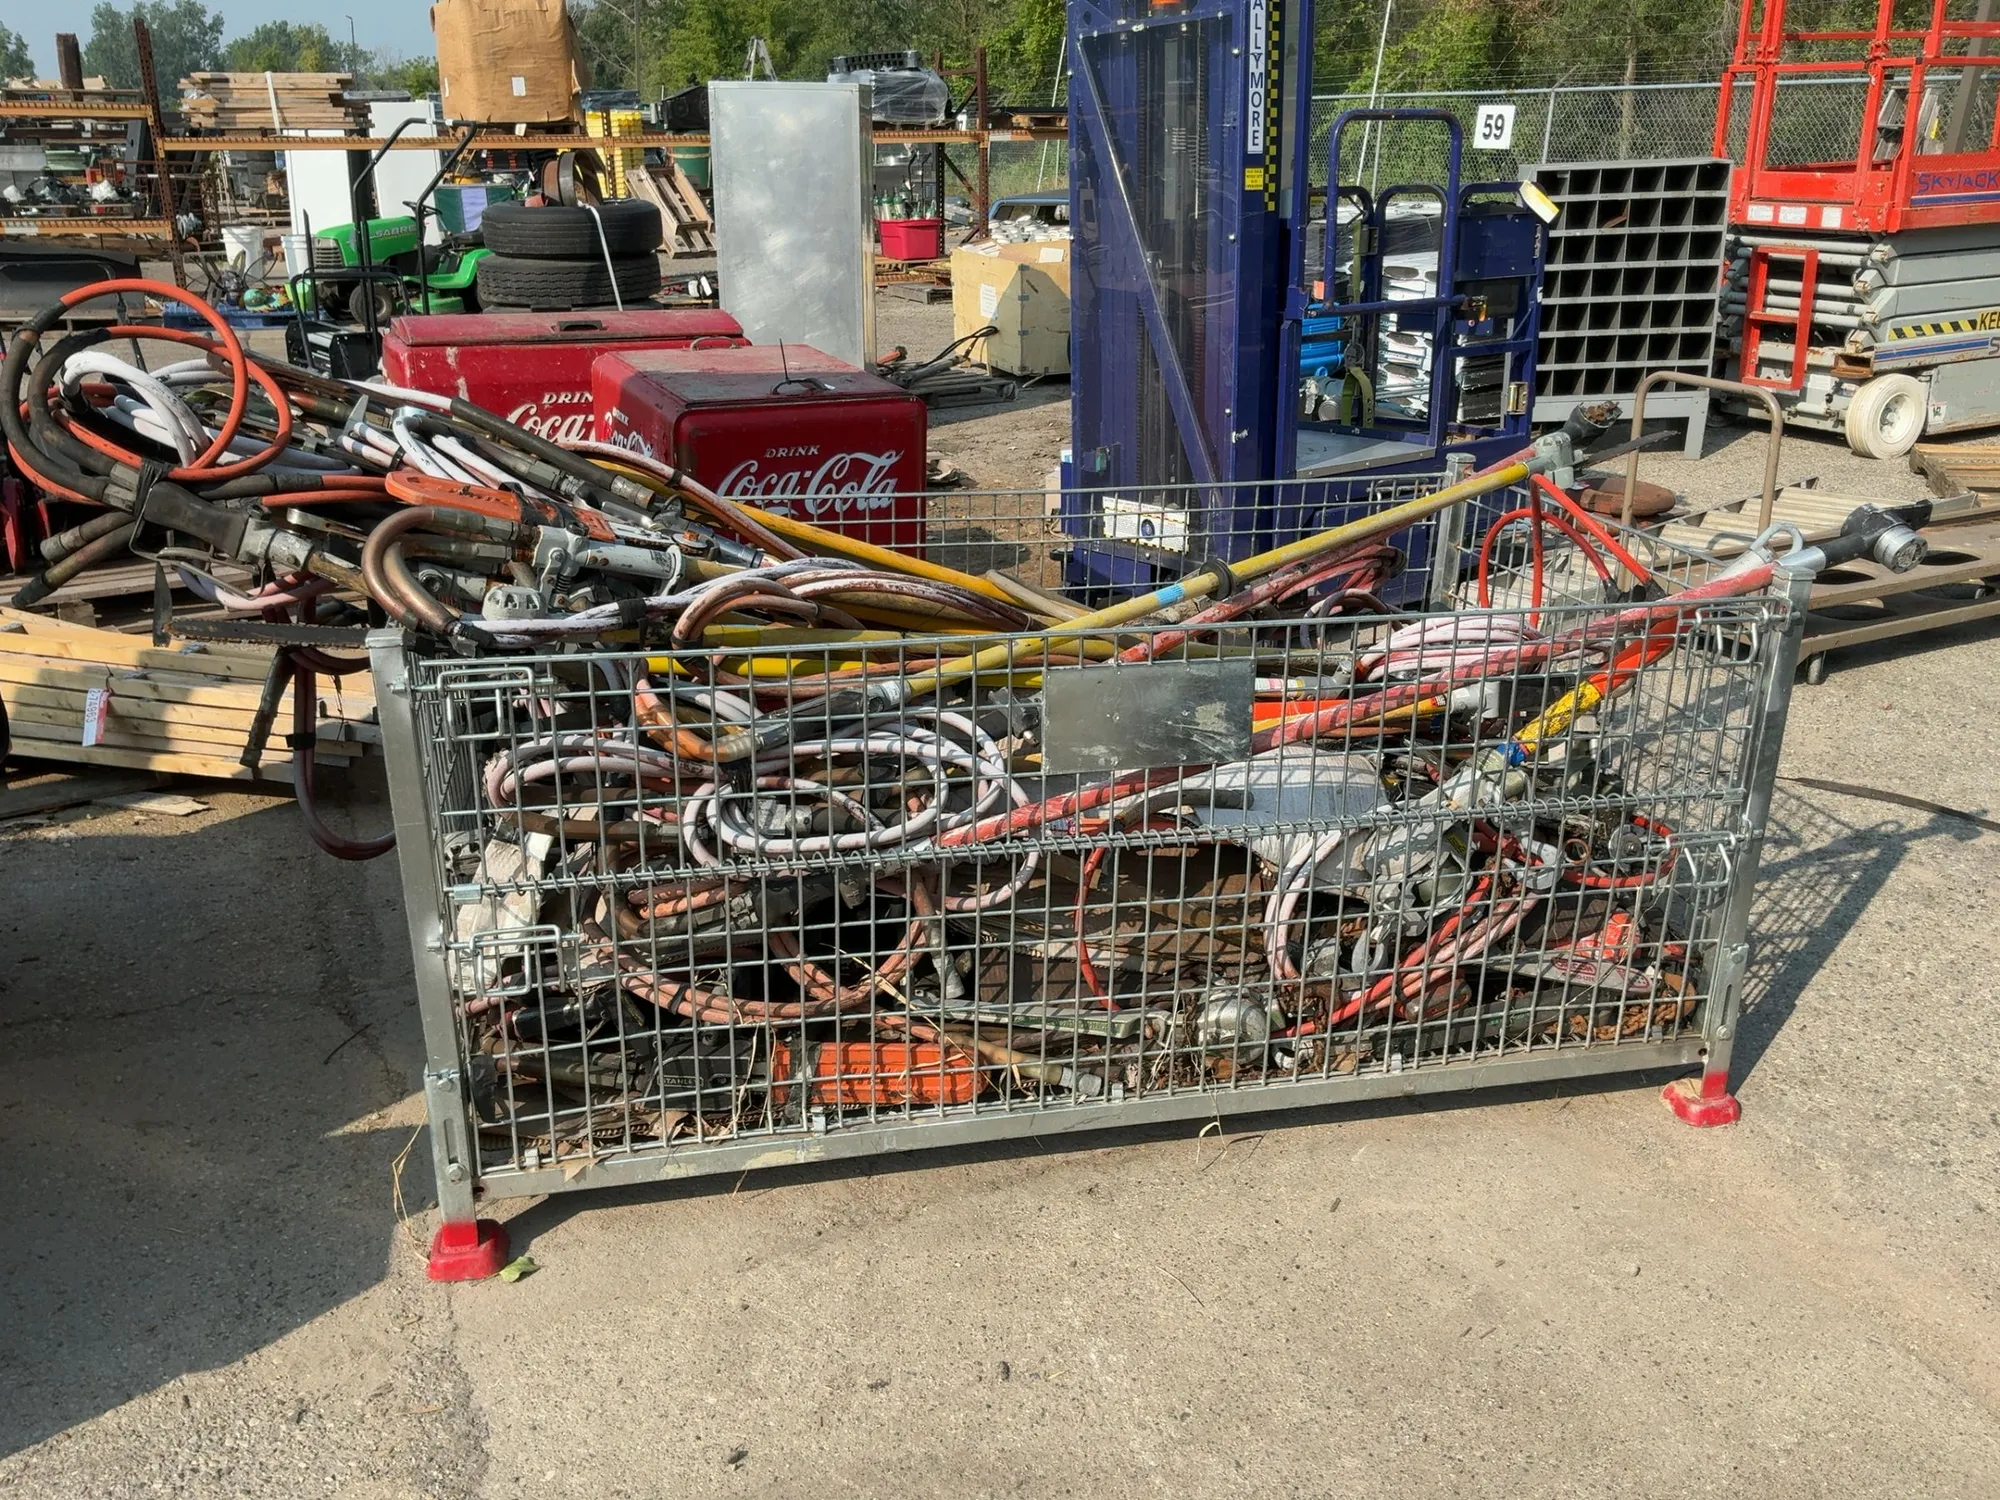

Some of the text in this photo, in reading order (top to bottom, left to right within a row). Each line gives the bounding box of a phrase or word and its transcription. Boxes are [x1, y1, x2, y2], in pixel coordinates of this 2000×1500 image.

[1482, 113, 1505, 141] 59
[764, 445, 820, 458] DRINK
[714, 450, 905, 516] Coca-Cola
